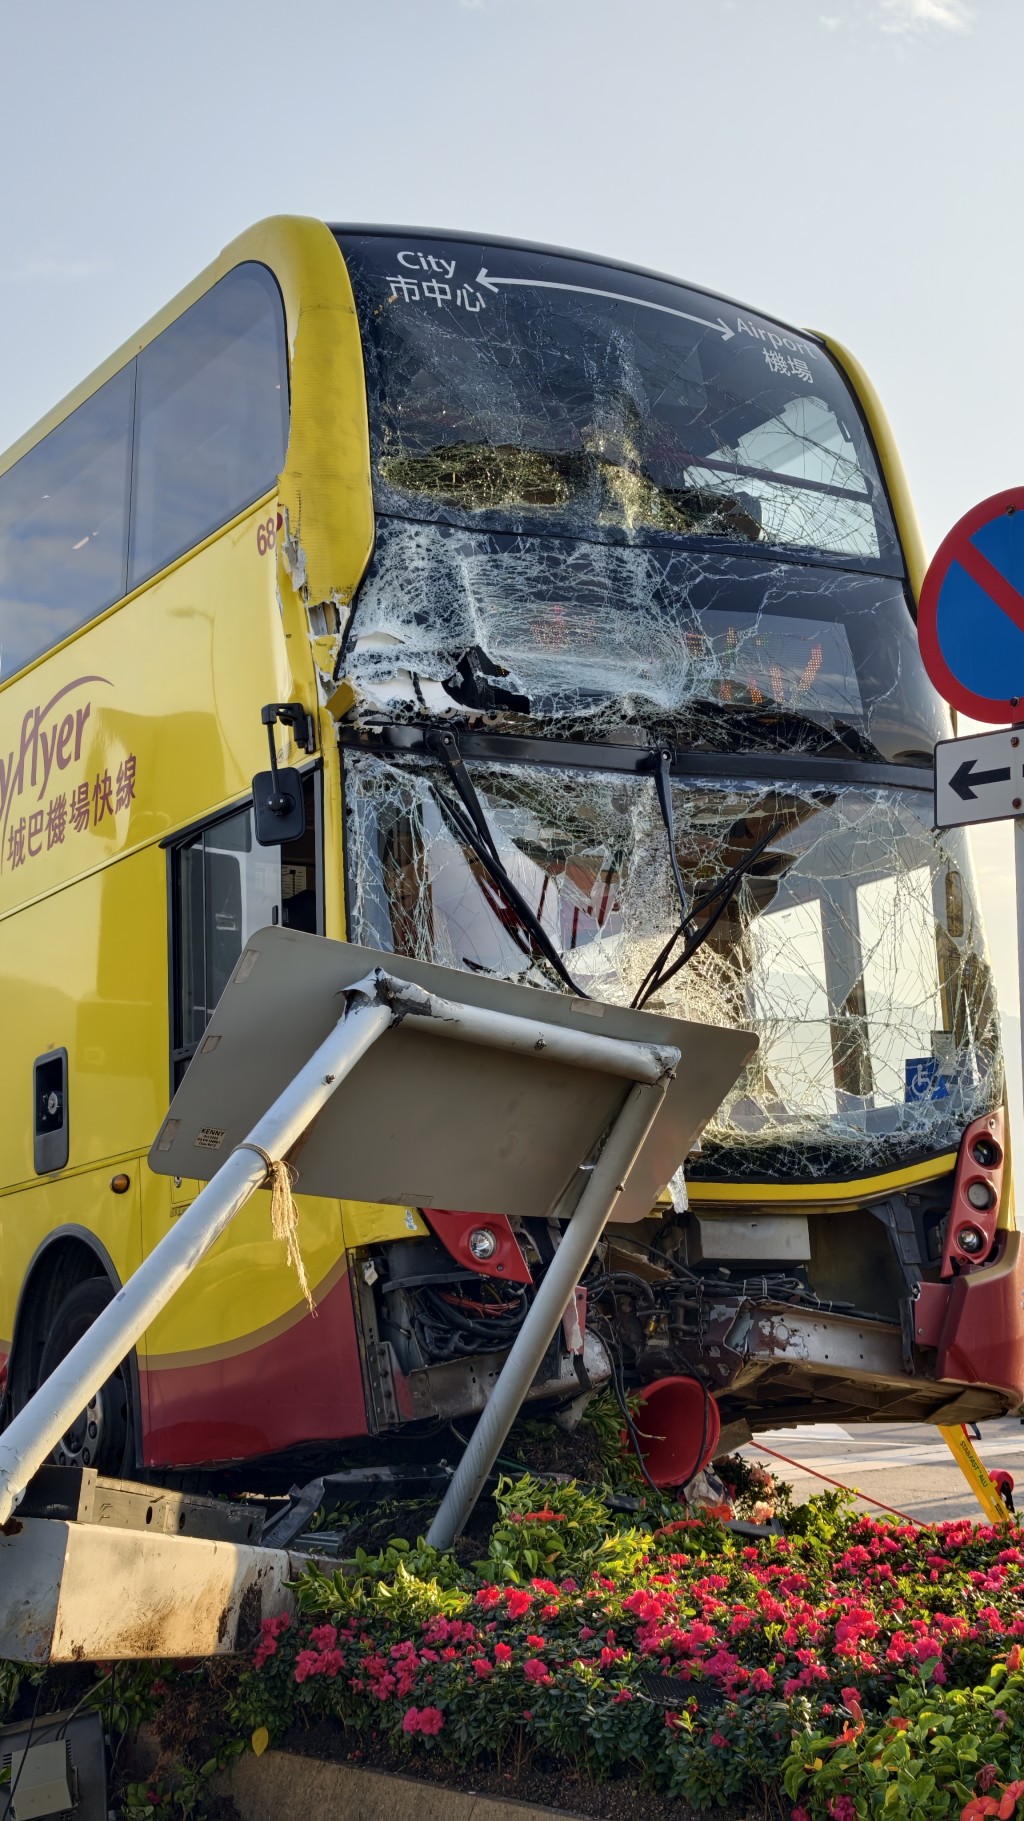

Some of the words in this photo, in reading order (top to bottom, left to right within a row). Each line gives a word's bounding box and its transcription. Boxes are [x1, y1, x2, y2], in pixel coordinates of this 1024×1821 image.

[397, 251, 456, 279] City
[386, 275, 486, 312] 市中心
[737, 317, 817, 360] Airport
[762, 347, 814, 384] 機場
[7, 753, 137, 870] 城巴機場快線
[200, 1128, 226, 1137] KENNY
